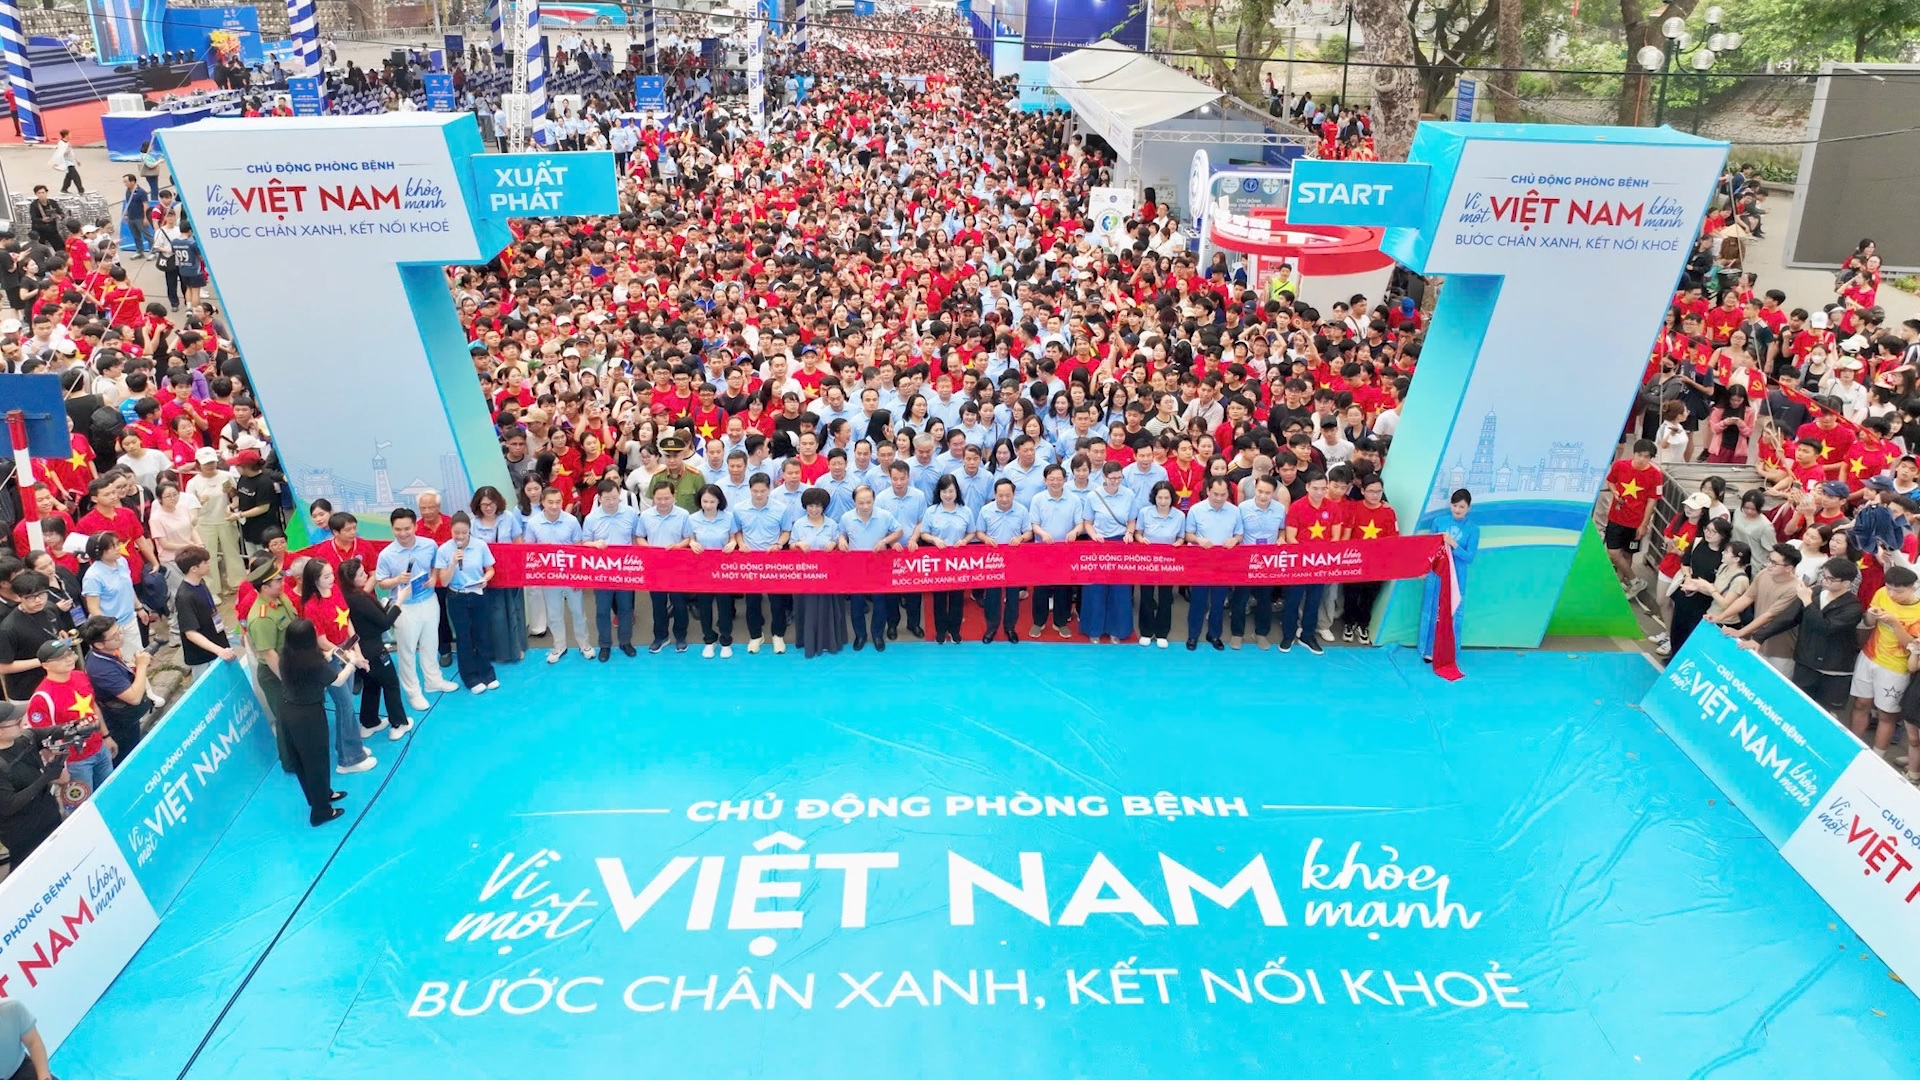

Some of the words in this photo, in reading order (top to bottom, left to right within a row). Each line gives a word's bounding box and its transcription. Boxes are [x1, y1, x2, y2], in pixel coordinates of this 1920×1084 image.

[246, 161, 272, 174] CHỦ
[276, 161, 312, 174] ĐỘNG
[315, 160, 359, 172] PHÒNG
[362, 160, 395, 172] BỆNH
[494, 160, 568, 187] XUẤT
[1511, 172, 1535, 184] CHỦ
[1538, 173, 1571, 187] ĐỘNG
[1575, 173, 1615, 187] PHÒNG
[1618, 177, 1649, 189] BỆNH
[207, 185, 223, 203] Vì
[231, 177, 307, 221] VIỆT
[318, 184, 401, 212] NAM
[404, 198, 447, 213] mạnh
[490, 186, 563, 211] PHÁT
[1298, 183, 1393, 205] START
[1464, 192, 1482, 210] Vì
[207, 200, 240, 221] một
[1459, 207, 1492, 227] một
[1490, 189, 1560, 231] VIỆT
[1567, 199, 1644, 227] NAM
[210, 224, 252, 239] BƯỚC
[255, 222, 297, 238] CHÂN
[301, 224, 347, 237] XANH,
[350, 221, 375, 235] KẾT
[379, 219, 406, 234] NỐI
[1643, 217, 1684, 232] mạnh
[1455, 233, 1494, 246] BƯỚC
[1497, 232, 1536, 247] CHÂN
[1540, 237, 1582, 250] XANH,
[1586, 234, 1609, 249] KẾT
[1613, 233, 1638, 250] NỐI
[175, 250, 189, 262] 99
[539, 549, 577, 571] VIỆT
[581, 555, 622, 571] NAM
[905, 554, 941, 576] VIỆT
[946, 556, 984, 571] NAM
[1262, 551, 1298, 572] VIỆT
[1302, 552, 1341, 567] NAM
[1669, 668, 1694, 692] một
[1677, 658, 1696, 676] Vì
[1690, 671, 1739, 724] VIỆT
[1716, 664, 1735, 684] CHỦ
[1732, 678, 1754, 701] ĐỘNG
[1752, 697, 1782, 726] PHÒNG
[1780, 723, 1807, 747] BỆNH
[239, 710, 261, 738] mạnh
[144, 772, 162, 794] CHỦ
[160, 747, 184, 776] ĐỘNG
[182, 718, 206, 752] PHÒNG
[205, 700, 224, 724] BỆNH
[192, 720, 240, 787] NAM
[1729, 715, 1792, 779] NAM
[143, 772, 194, 837] VIỆT
[1779, 776, 1811, 808] mạnh
[1829, 796, 1850, 816] Vì
[686, 792, 786, 822] CHỦ
[795, 793, 933, 825] ĐỘNG
[946, 791, 1110, 817] PHÒNG
[1121, 792, 1249, 821] BỆNH
[1818, 812, 1849, 837] một
[1881, 808, 1904, 831] CHỦ
[1903, 828, 1920, 851] ĐỘ
[136, 831, 158, 868] một
[1847, 814, 1913, 884] VIỆT
[479, 848, 561, 902] Vì
[1301, 837, 1450, 893] khỏe
[594, 830, 900, 957] VIỆT
[947, 850, 1288, 927] NAM
[3, 901, 43, 947] PHÒNG
[42, 871, 72, 905] BỆNH
[444, 887, 600, 955] một
[1304, 890, 1482, 941] mạnh
[17, 895, 95, 988] NAM
[95, 876, 126, 916] mạnh
[407, 967, 604, 1017] BƯỚC
[622, 965, 815, 1012] CHÂN
[835, 969, 1046, 1010] XANH,
[1067, 955, 1180, 1006] KẾT
[1201, 955, 1327, 1005] NỐI
[1339, 960, 1530, 1010] KHOẺ
